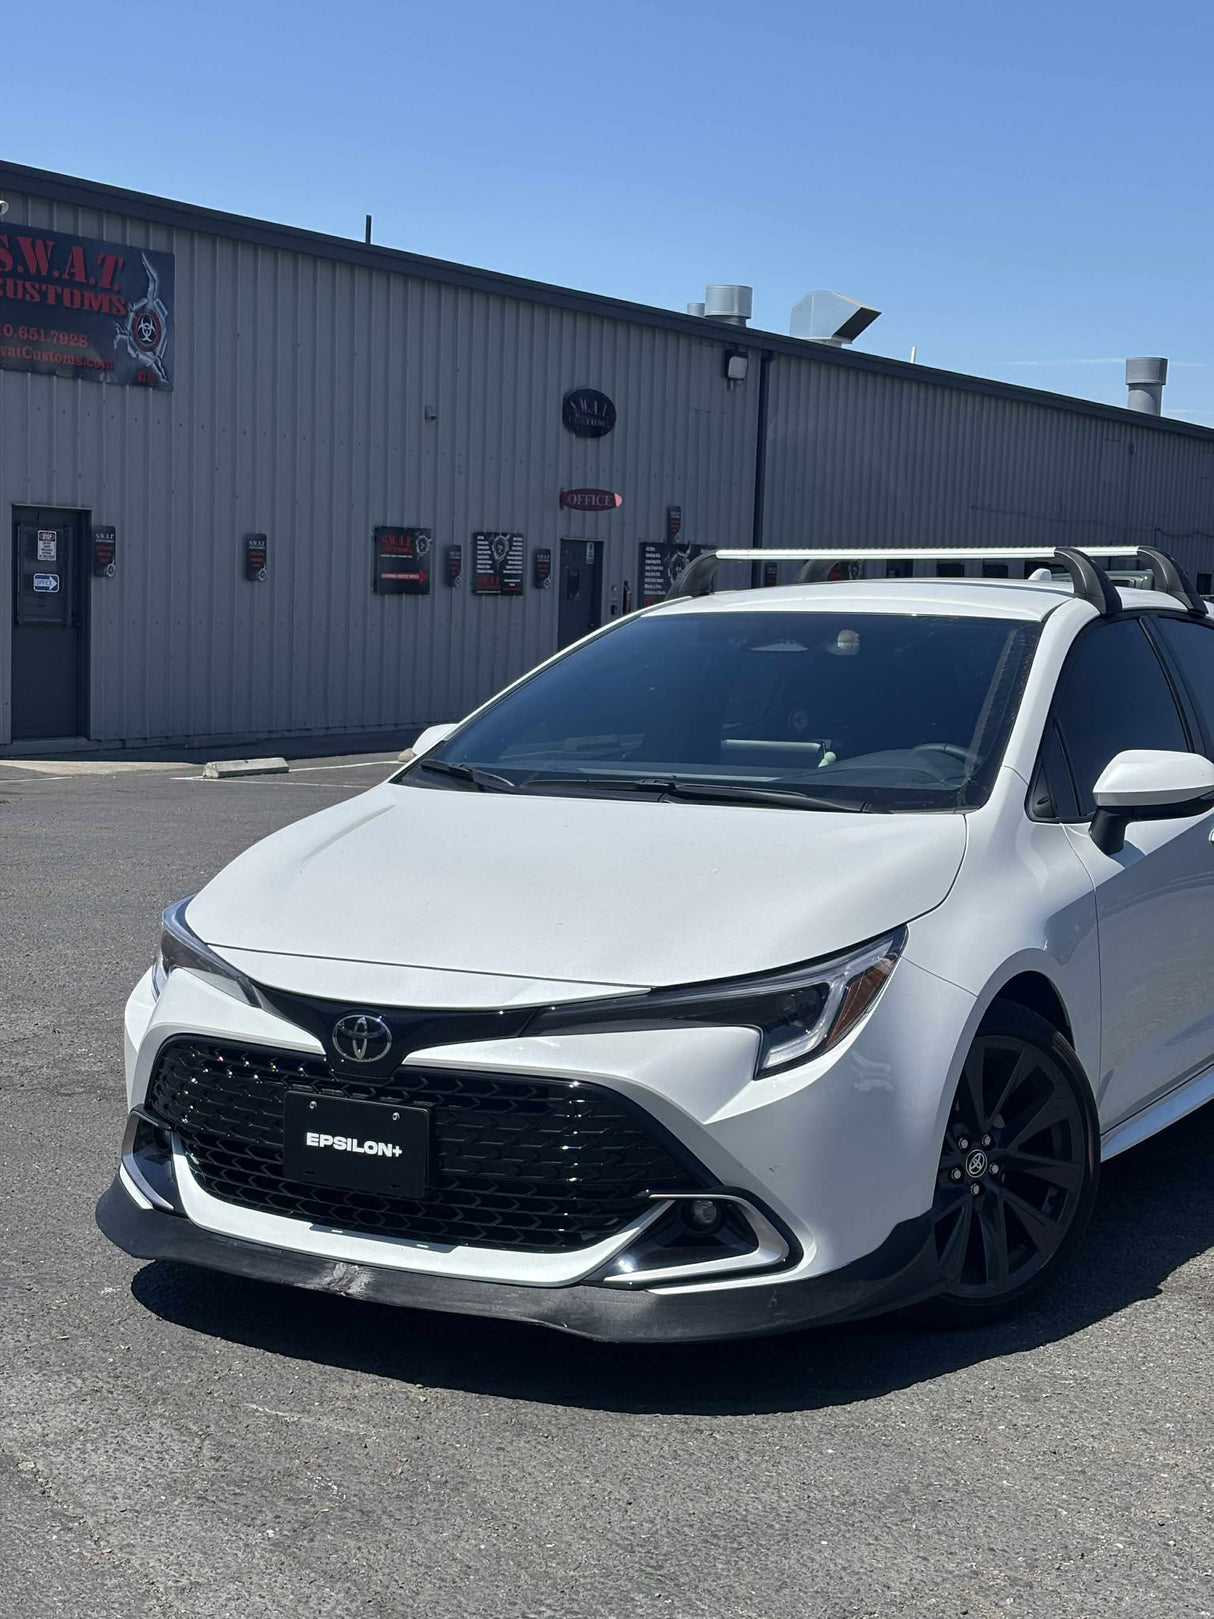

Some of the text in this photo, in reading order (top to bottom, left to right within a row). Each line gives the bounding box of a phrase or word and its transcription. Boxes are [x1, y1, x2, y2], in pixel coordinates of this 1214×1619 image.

[0, 278, 127, 316] USTOMS
[0, 323, 89, 348] 0.651.7928
[567, 494, 613, 506] OFFICE
[306, 1132, 402, 1157] EPSILON+
